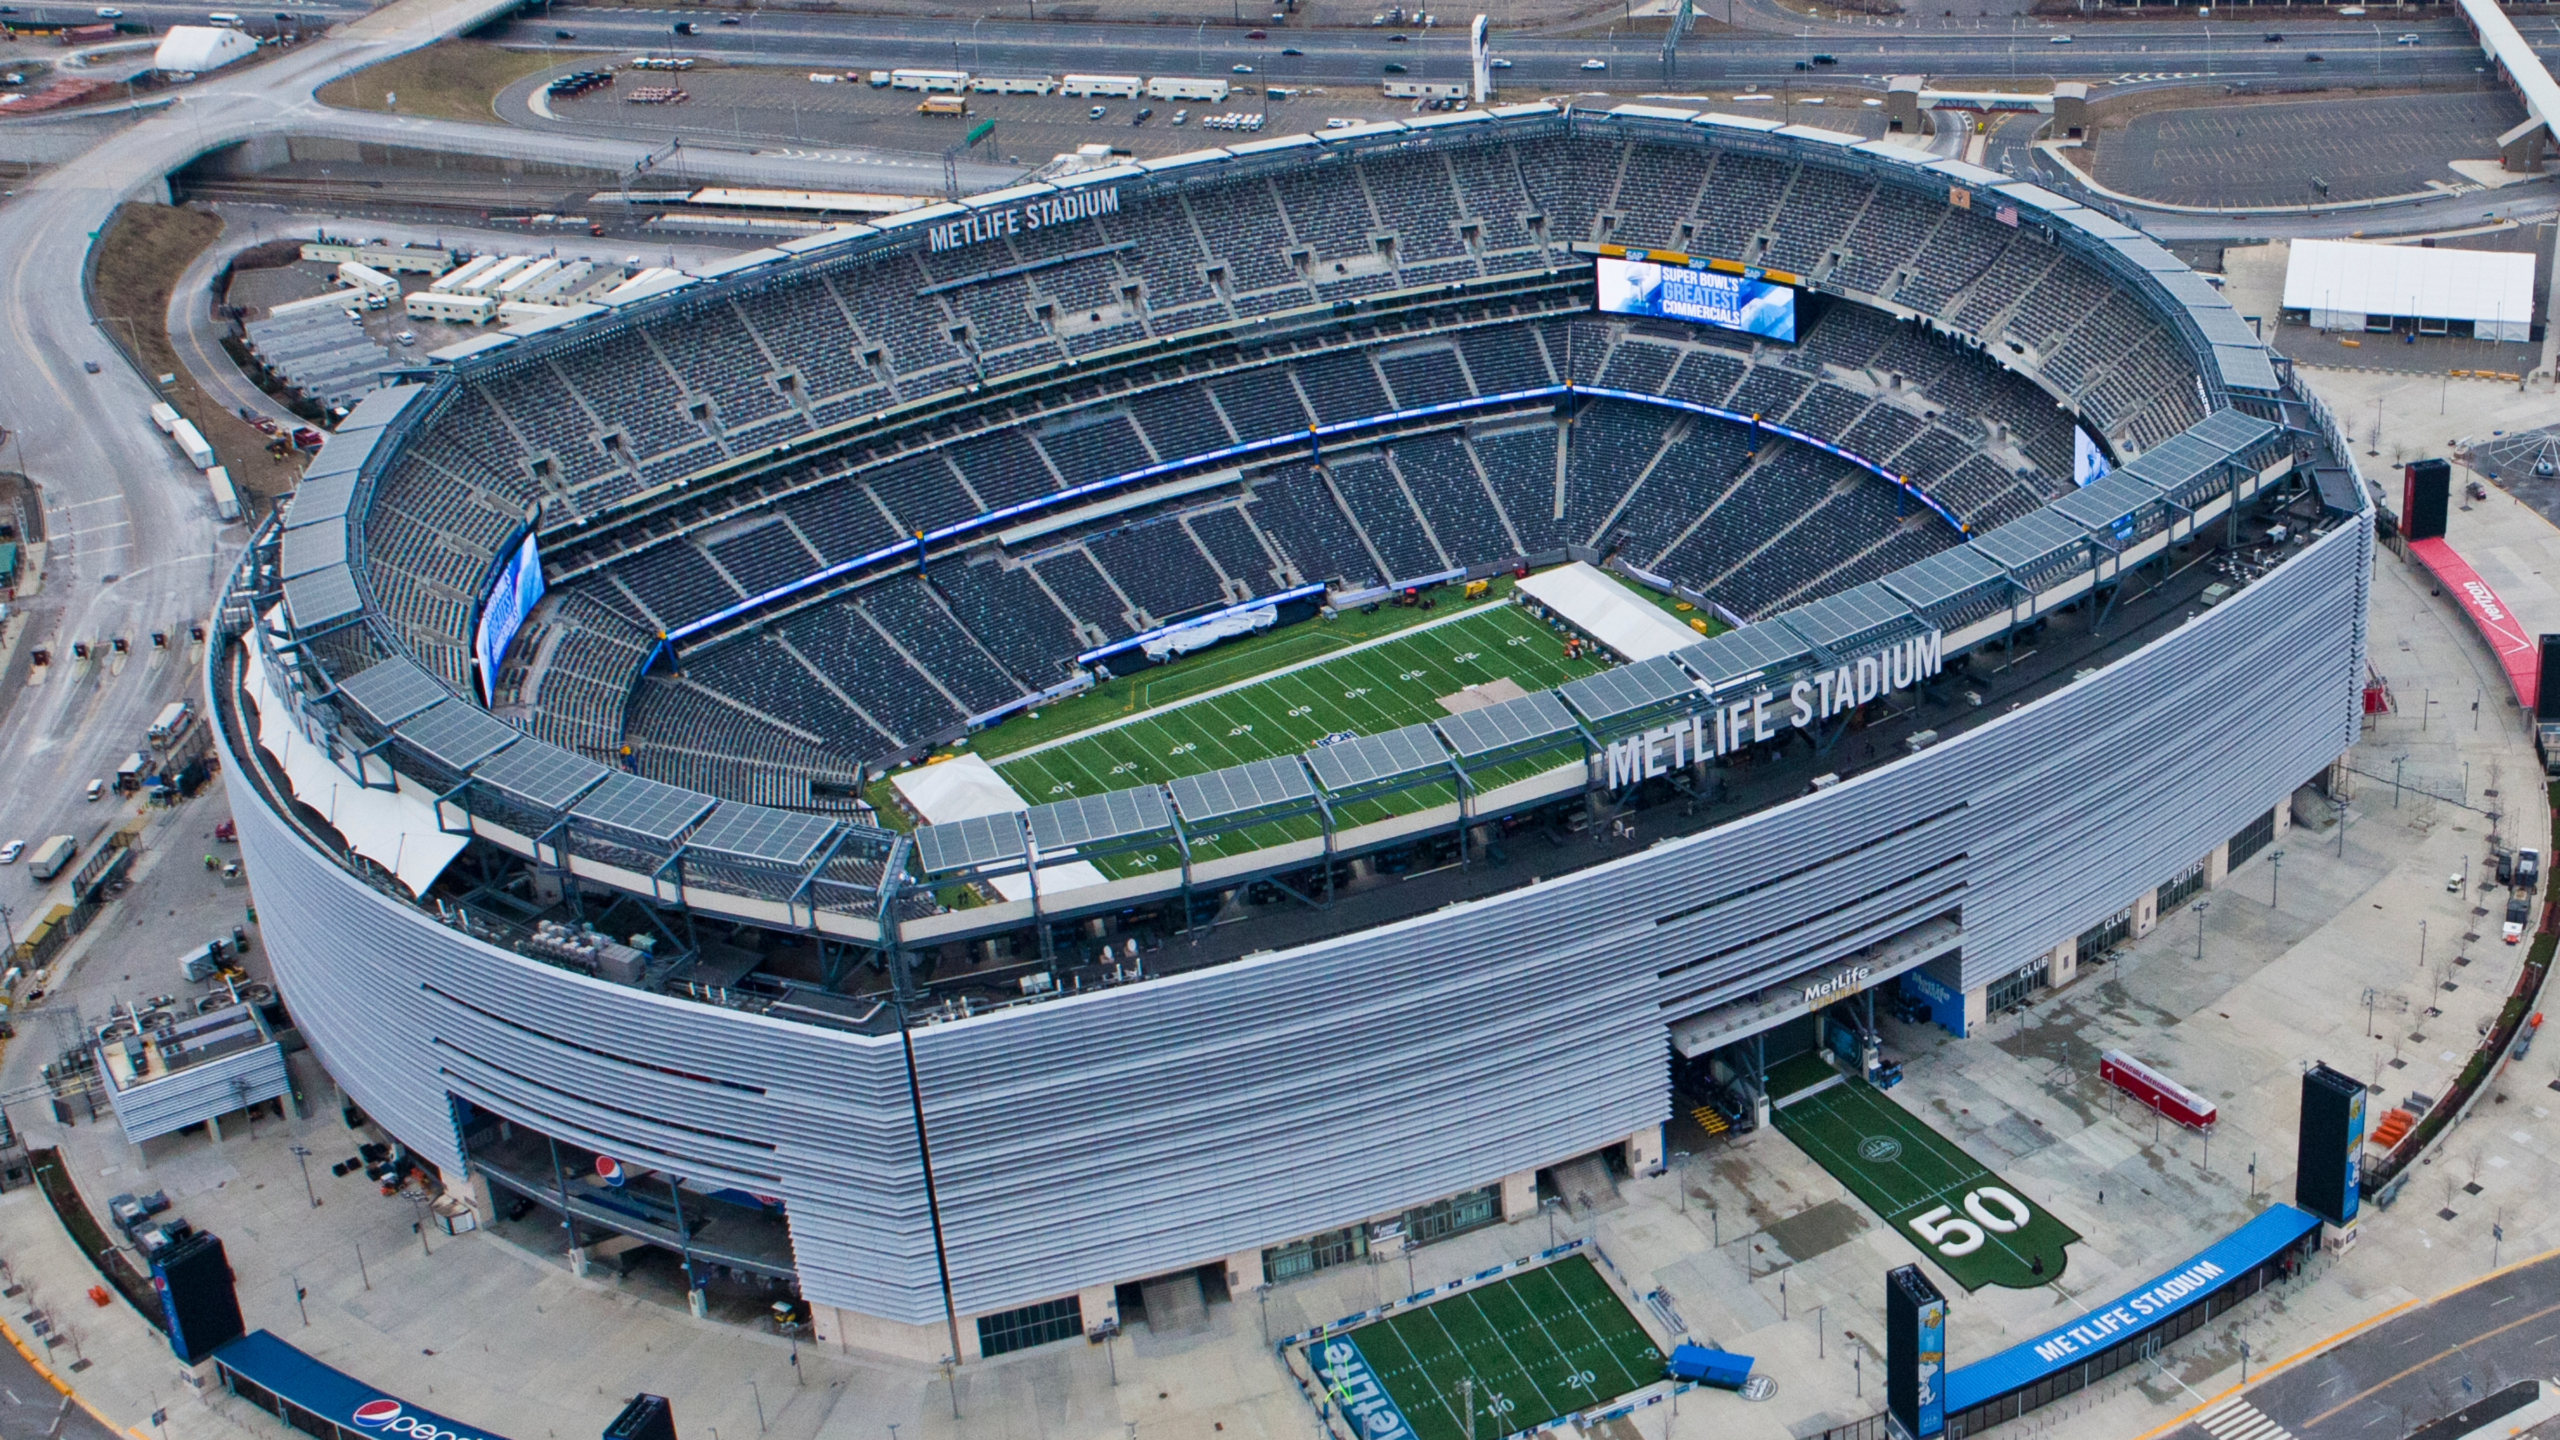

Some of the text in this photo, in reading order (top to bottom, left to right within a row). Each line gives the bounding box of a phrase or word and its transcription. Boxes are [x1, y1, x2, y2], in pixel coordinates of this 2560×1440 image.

[930, 187, 1119, 252] METLIFE STADIUM
[1626, 250, 1645, 262] SAP
[1689, 258, 1706, 269] SAP
[1663, 268, 1739, 293] SUPER BOWL'S
[1744, 268, 1761, 280] SAP
[1664, 282, 1739, 311] GREATEST
[1663, 300, 1740, 325] COMMERCIALS
[1913, 313, 1999, 372] MetLife
[2463, 581, 2504, 621] verizon
[1507, 635, 1529, 646] 10
[1454, 652, 1476, 663] 20
[1400, 670, 1423, 681] 30
[1345, 687, 1367, 699] 40
[1288, 705, 1312, 717] 50
[1608, 629, 1942, 790] METLIFE STADIUM
[1230, 724, 1253, 736] 40
[1173, 743, 1197, 755] 30
[1113, 761, 1137, 774] 20
[1052, 781, 1076, 794] 10
[1133, 854, 1158, 867] 10
[2172, 859, 2204, 888] SUITES
[2105, 907, 2131, 931] CLUB
[2020, 955, 2048, 979] CLUB
[1805, 966, 1869, 1002] MetLife
[1809, 982, 1862, 1012] CENTRAL
[2115, 1058, 2190, 1105] OFFICIAL MERCHANDISE
[1909, 1186, 2030, 1257] 50
[2034, 1260, 2224, 1362] METLIFE STADIUM
[1320, 1343, 1408, 1440] etLife
[1566, 1370, 1596, 1389] 20
[1488, 1398, 1515, 1418] 10
